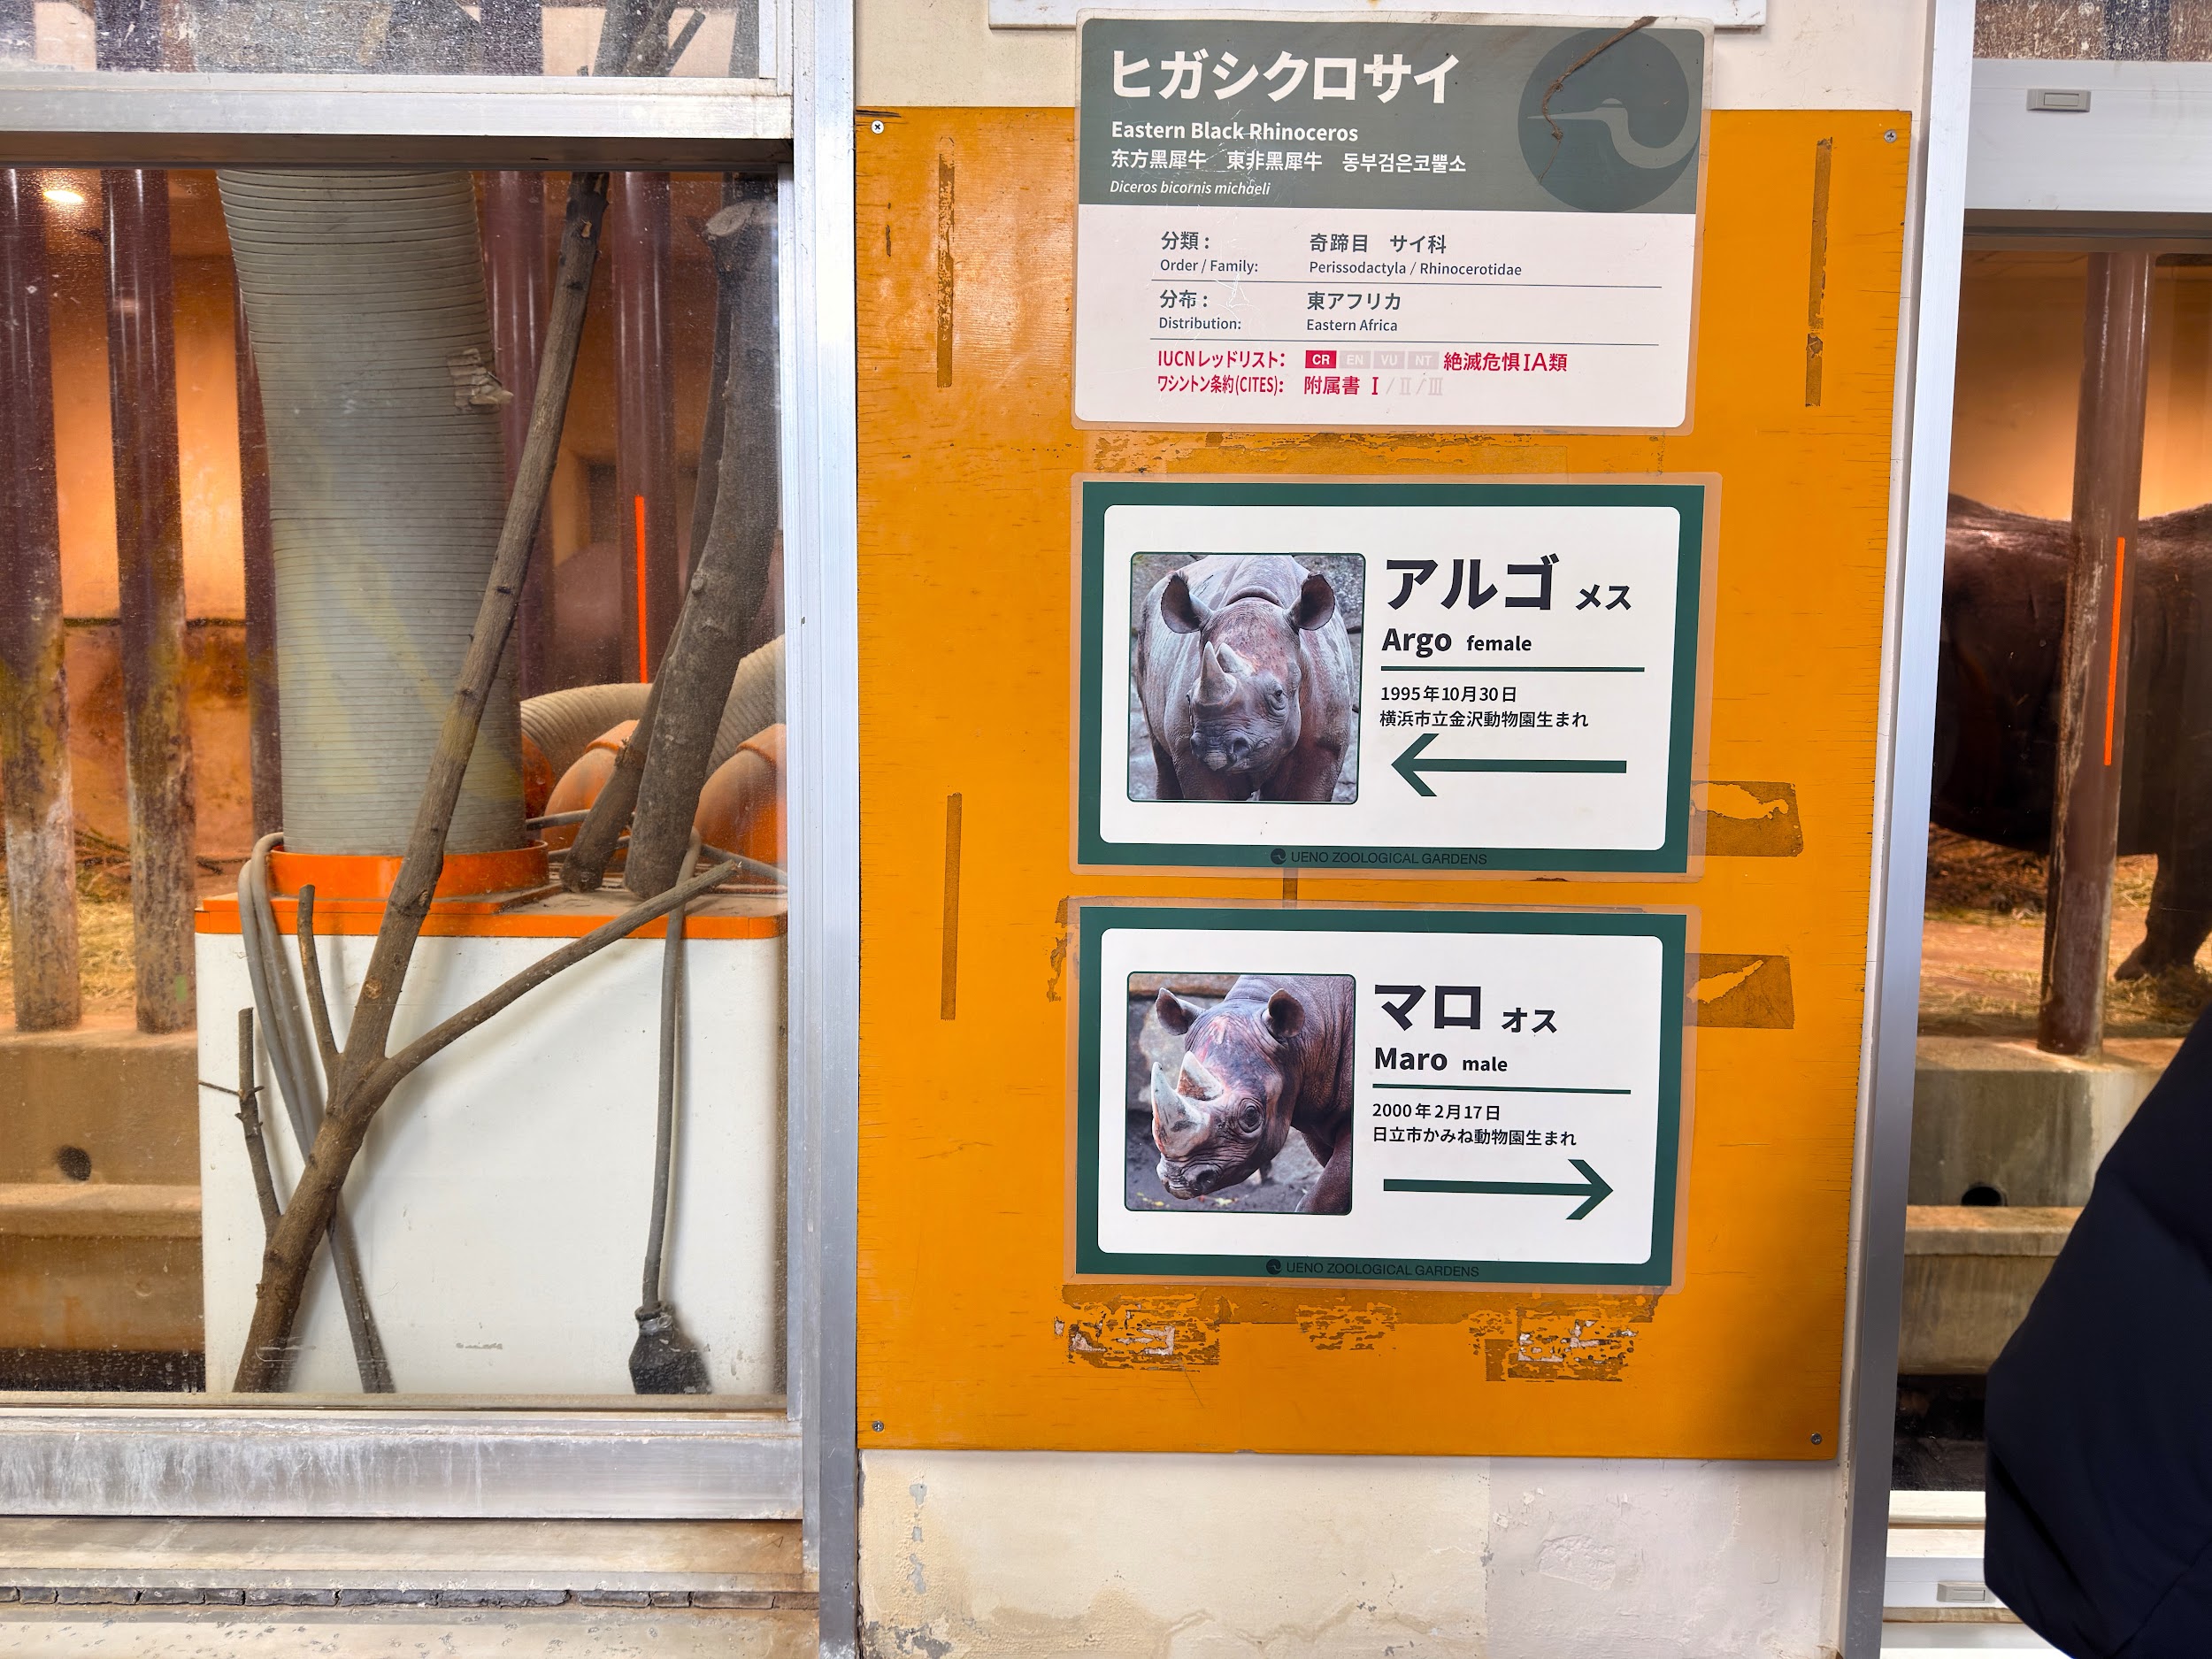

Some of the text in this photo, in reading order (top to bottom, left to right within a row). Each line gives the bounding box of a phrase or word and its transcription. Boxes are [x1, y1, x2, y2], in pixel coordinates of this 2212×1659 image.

[1113, 48, 1460, 104] ヒガシクロサイ
[1111, 120, 1358, 142] Eastern Black Rhinoceros
[1111, 149, 1323, 171] 东方黑犀牛 東非黑犀牛
[1341, 152, 1467, 173] 동부검은코뿔소
[1110, 180, 1271, 196] Diceros bicornis michaeli
[1310, 233, 1368, 253] 奇蹄目
[1389, 234, 1447, 254] サイ科
[1160, 258, 1522, 277] Order / Family: Perissodactyla / Rhinocerotidae
[1307, 290, 1401, 311] 東アフリカ
[1159, 316, 1398, 332] Distribution: Eastern Africa
[1312, 354, 1331, 365] CR
[1346, 354, 1363, 365] EN
[1380, 354, 1398, 366] VU
[1415, 355, 1432, 366] NT
[1303, 375, 1361, 396] 附属書
[1386, 553, 1632, 611] アルゴ メス
[1381, 627, 1532, 658] Argo female
[1380, 685, 1517, 703] 1995年10月30日
[1379, 710, 1589, 728] 横浜市立金沢動物園生まれ
[1291, 851, 1487, 865] UENO ZOOLOGICAL GARDENS
[1374, 984, 1557, 1033] マロ オス
[1375, 1047, 1508, 1072] Maro male
[1372, 1102, 1500, 1121] 2000年2月17日
[1373, 1126, 1577, 1146] 日立市かみね動物園生まれ
[1286, 1262, 1479, 1278] UENO ZOOLOGICAL GARDENS
